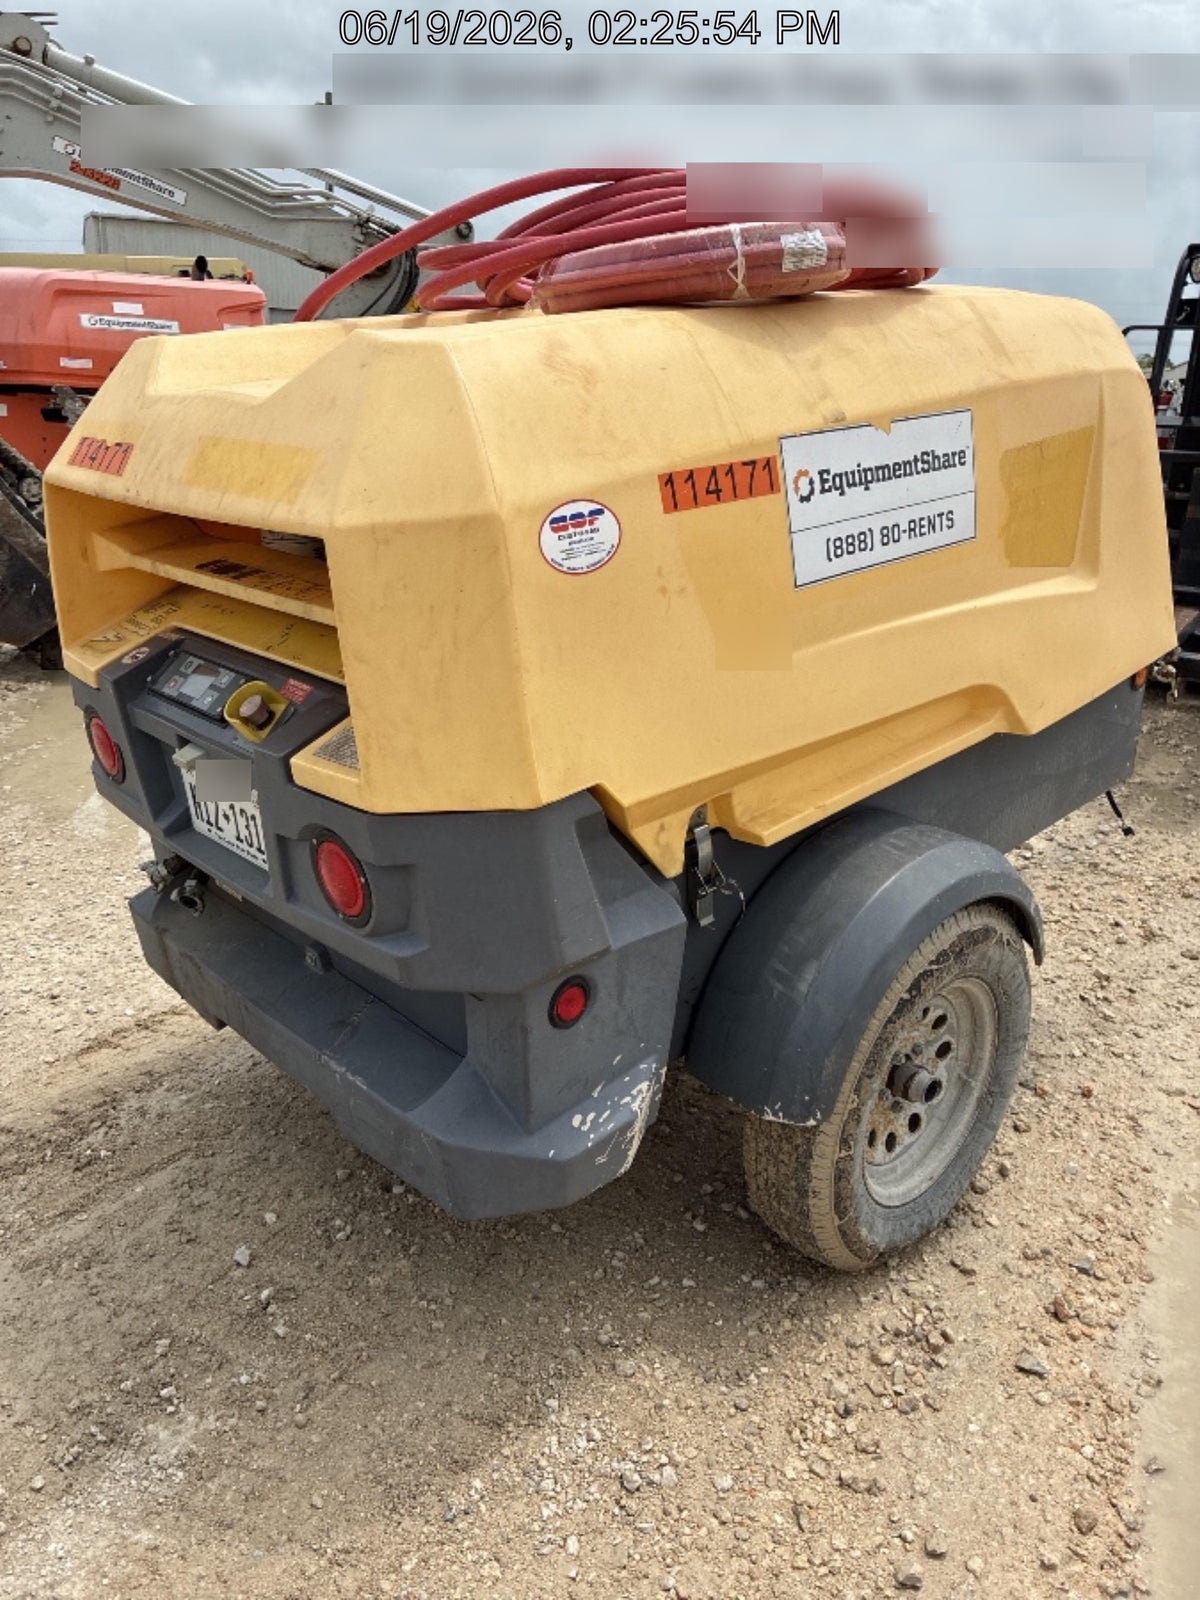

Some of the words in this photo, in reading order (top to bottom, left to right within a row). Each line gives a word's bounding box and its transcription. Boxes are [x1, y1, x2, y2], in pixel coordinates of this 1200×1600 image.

[664, 456, 775, 510] 114171
[817, 448, 967, 496] EquipmentShare
[826, 528, 874, 562] (888)
[880, 510, 954, 548] 80-RENTS
